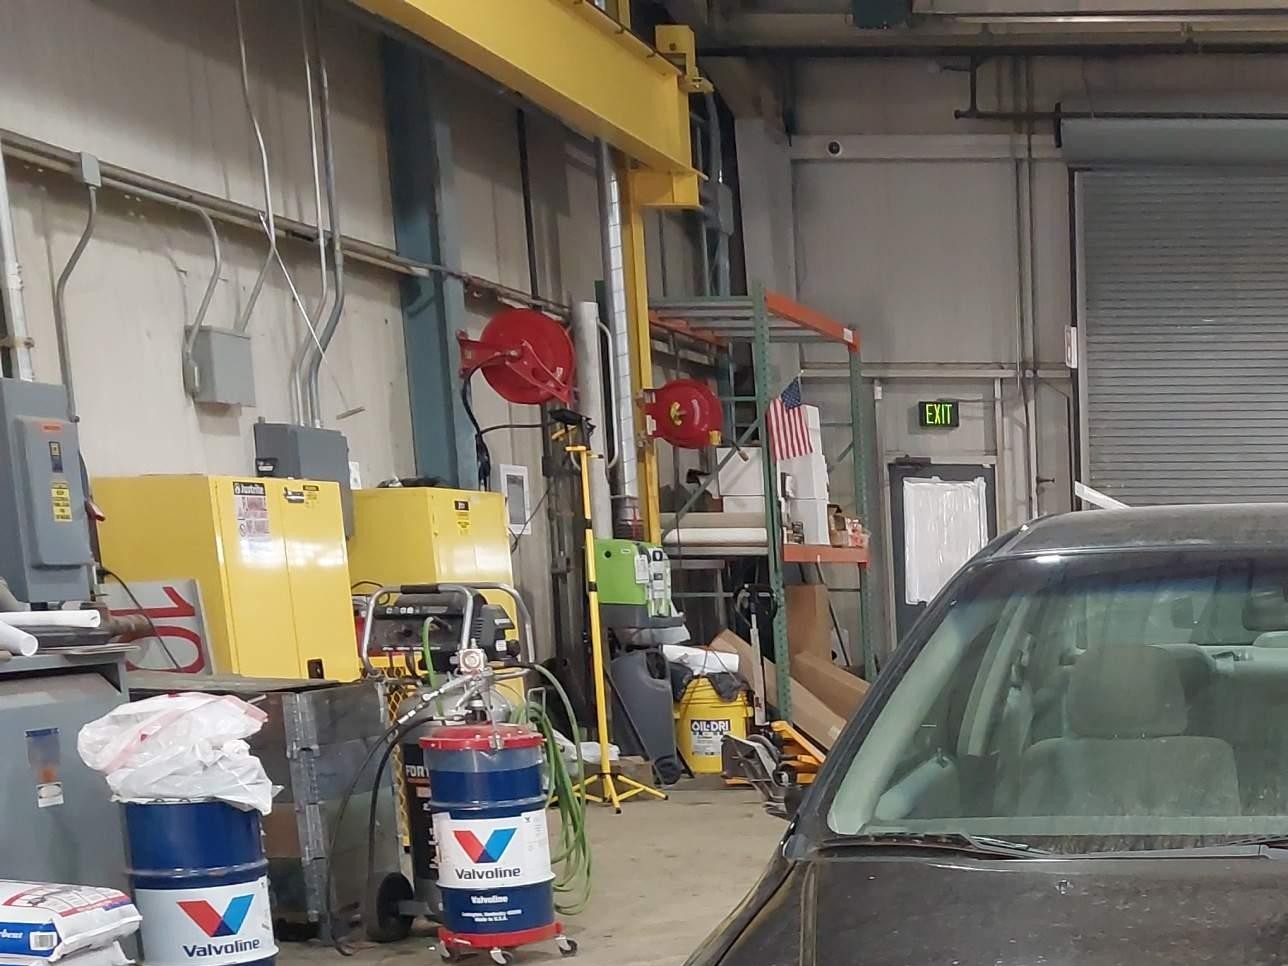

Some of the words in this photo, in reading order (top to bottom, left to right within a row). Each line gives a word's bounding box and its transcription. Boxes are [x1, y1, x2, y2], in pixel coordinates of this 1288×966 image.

[926, 404, 952, 424] EXIT
[455, 867, 521, 880] Valvoline
[471, 895, 508, 904] Valvoline
[183, 938, 260, 957] Valvoline
